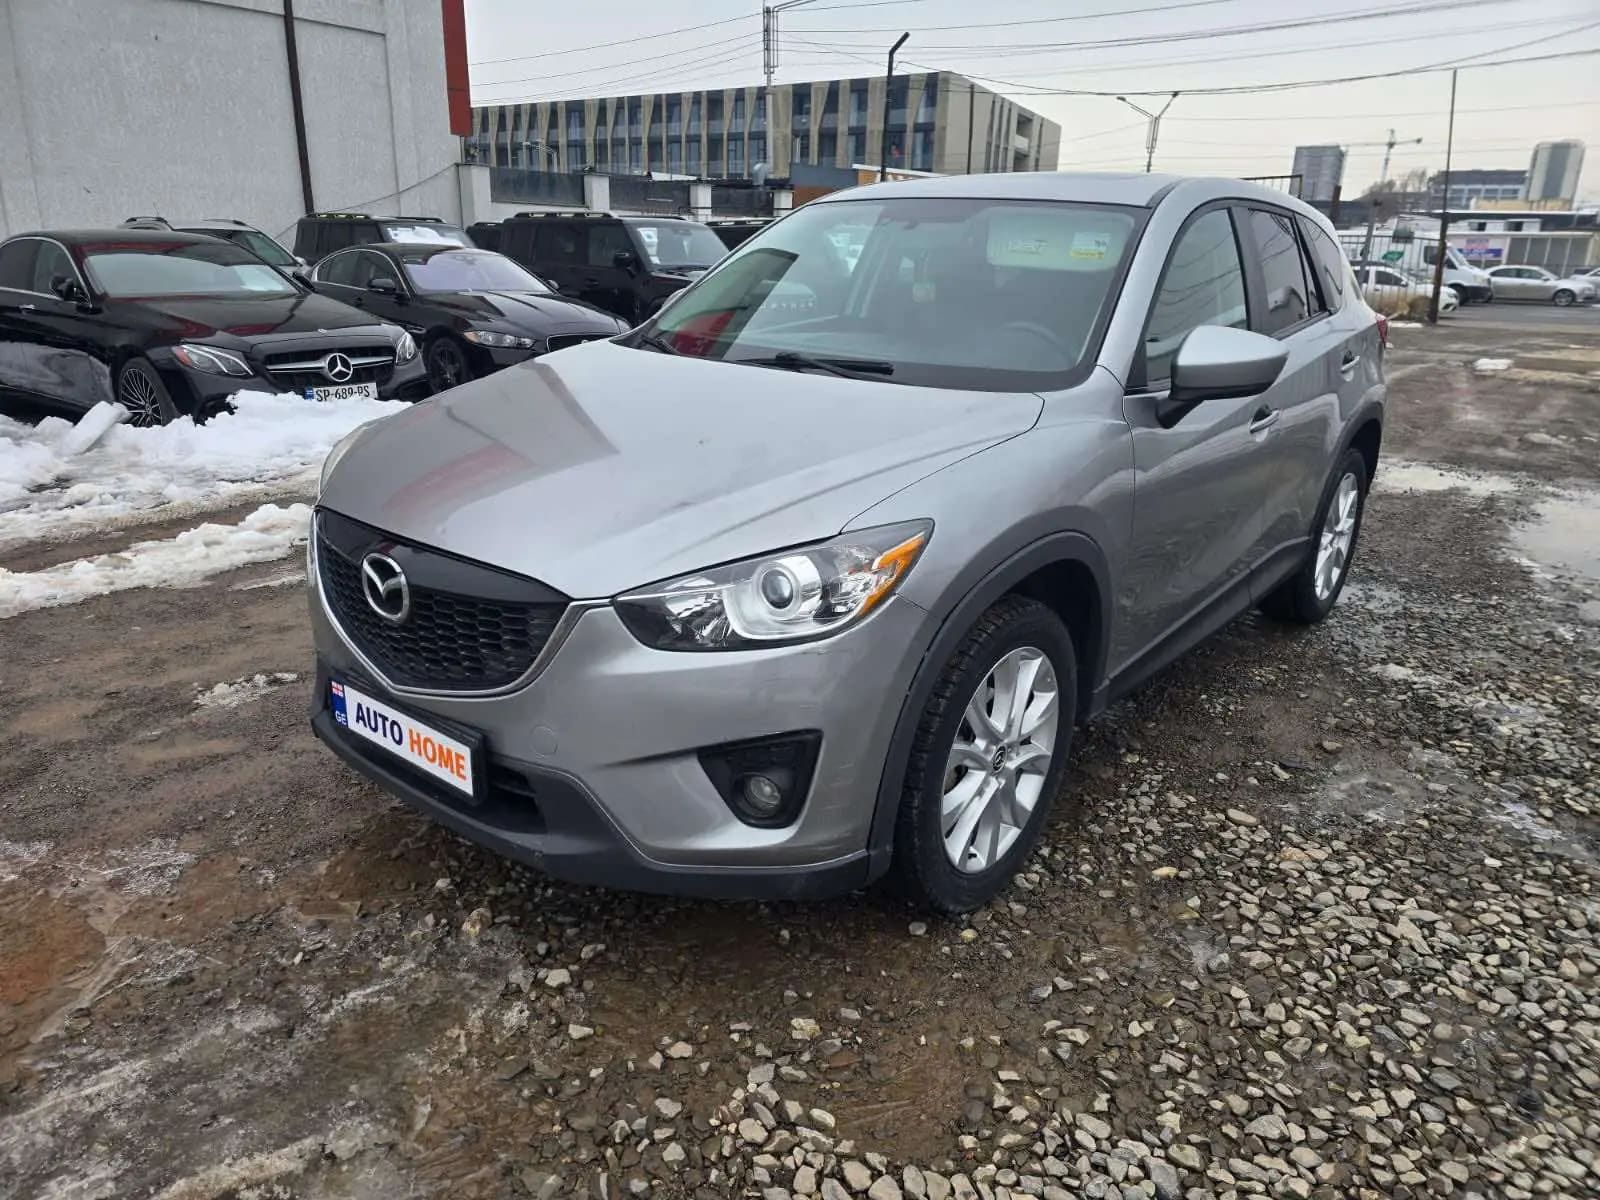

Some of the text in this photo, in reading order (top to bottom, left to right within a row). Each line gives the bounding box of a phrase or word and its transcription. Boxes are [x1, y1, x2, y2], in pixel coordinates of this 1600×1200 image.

[315, 385, 370, 402] SP-689-PS
[335, 710, 347, 725] GE
[355, 702, 467, 780] AUTO HOME
